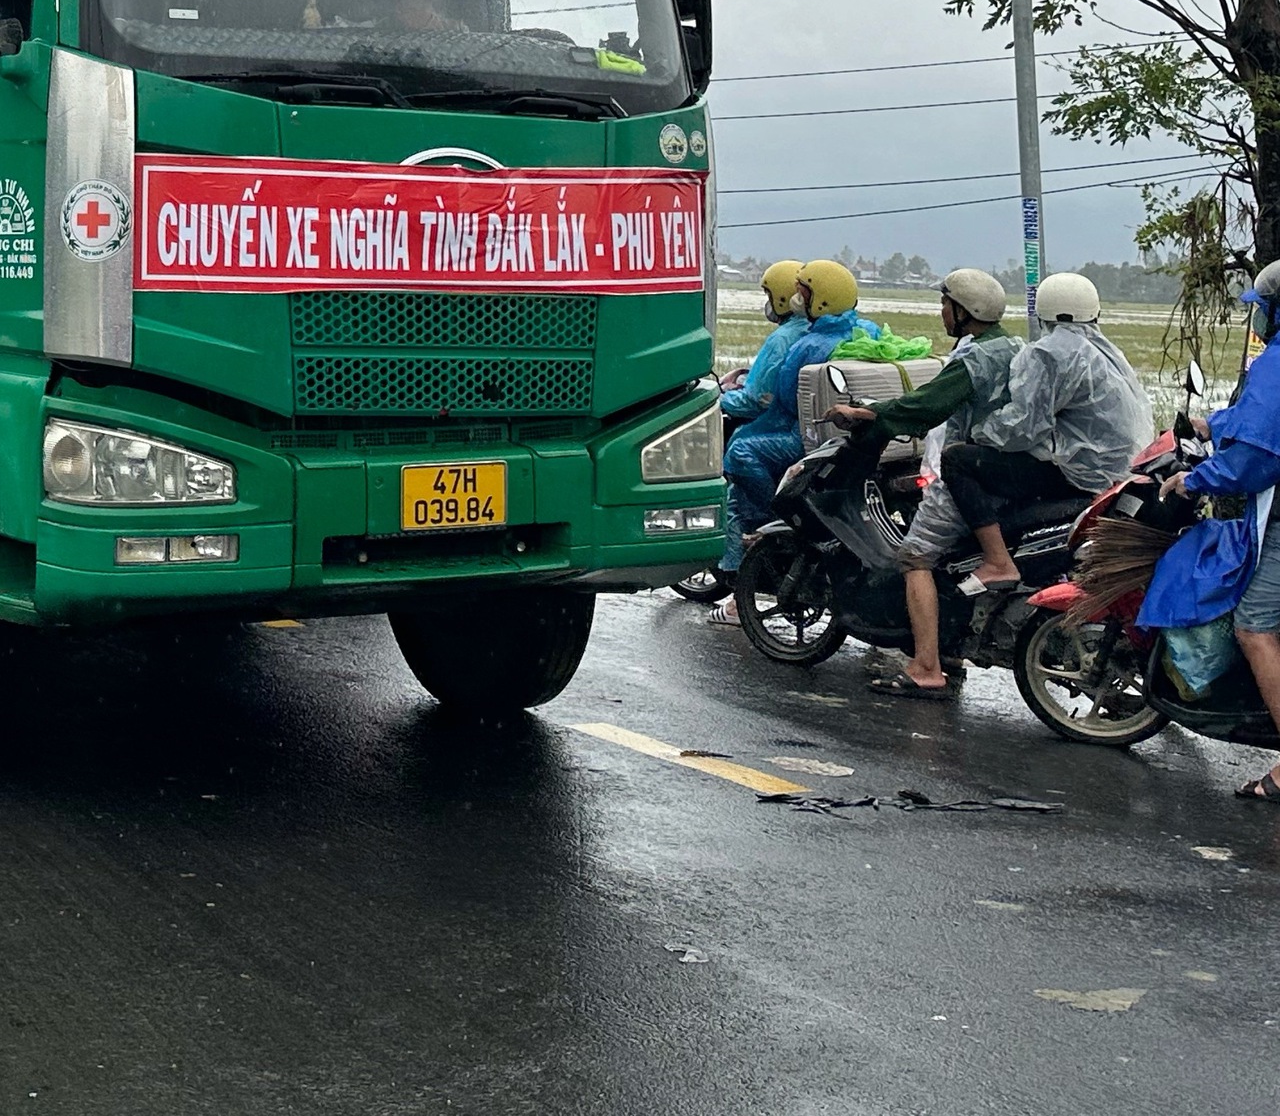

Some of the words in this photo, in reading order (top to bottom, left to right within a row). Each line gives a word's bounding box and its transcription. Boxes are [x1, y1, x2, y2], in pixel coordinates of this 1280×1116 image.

[157, 180, 277, 269] CHUYẾN
[285, 207, 320, 269] XE
[330, 194, 410, 271] NGHĨA
[420, 195, 478, 272] TÌNH
[485, 186, 535, 272] ĐẮK
[541, 186, 589, 272] LẮK
[595, 243, 604, 257] -
[611, 196, 655, 271] PHÚ
[660, 196, 697, 269] YÊN
[12, 239, 34, 252] CHI
[433, 468, 477, 494] 47H
[414, 496, 495, 525] 039.84
